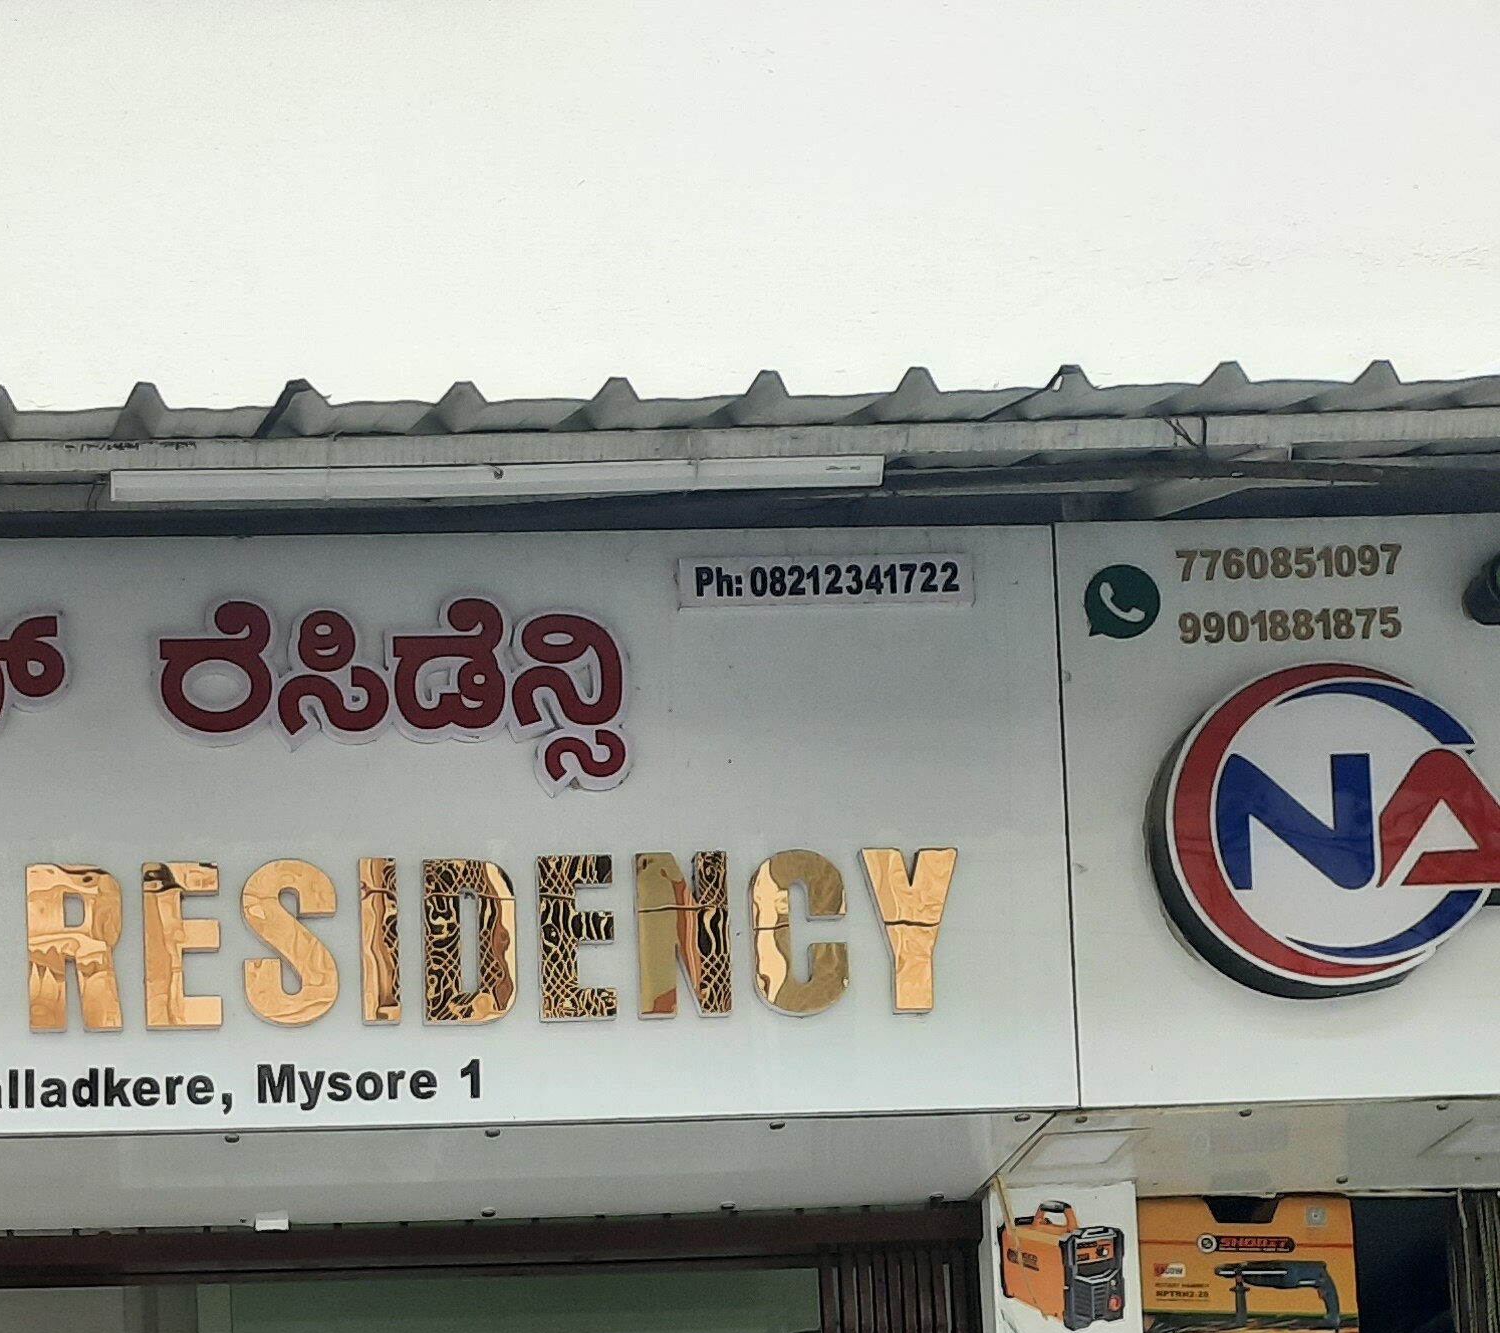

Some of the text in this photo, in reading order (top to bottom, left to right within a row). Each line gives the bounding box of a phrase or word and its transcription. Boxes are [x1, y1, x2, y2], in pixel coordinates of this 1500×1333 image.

[749, 561, 960, 596] 08212341722
[1175, 543, 1403, 582] 7760851097
[1177, 606, 1403, 644] 9901881875
[157, 597, 626, 782] ರೆಸಿಡೆನ್ಸಿ
[24, 846, 959, 1033] RESIDENCY
[256, 1062, 440, 1111] Mysore
[459, 1058, 482, 1099] 1
